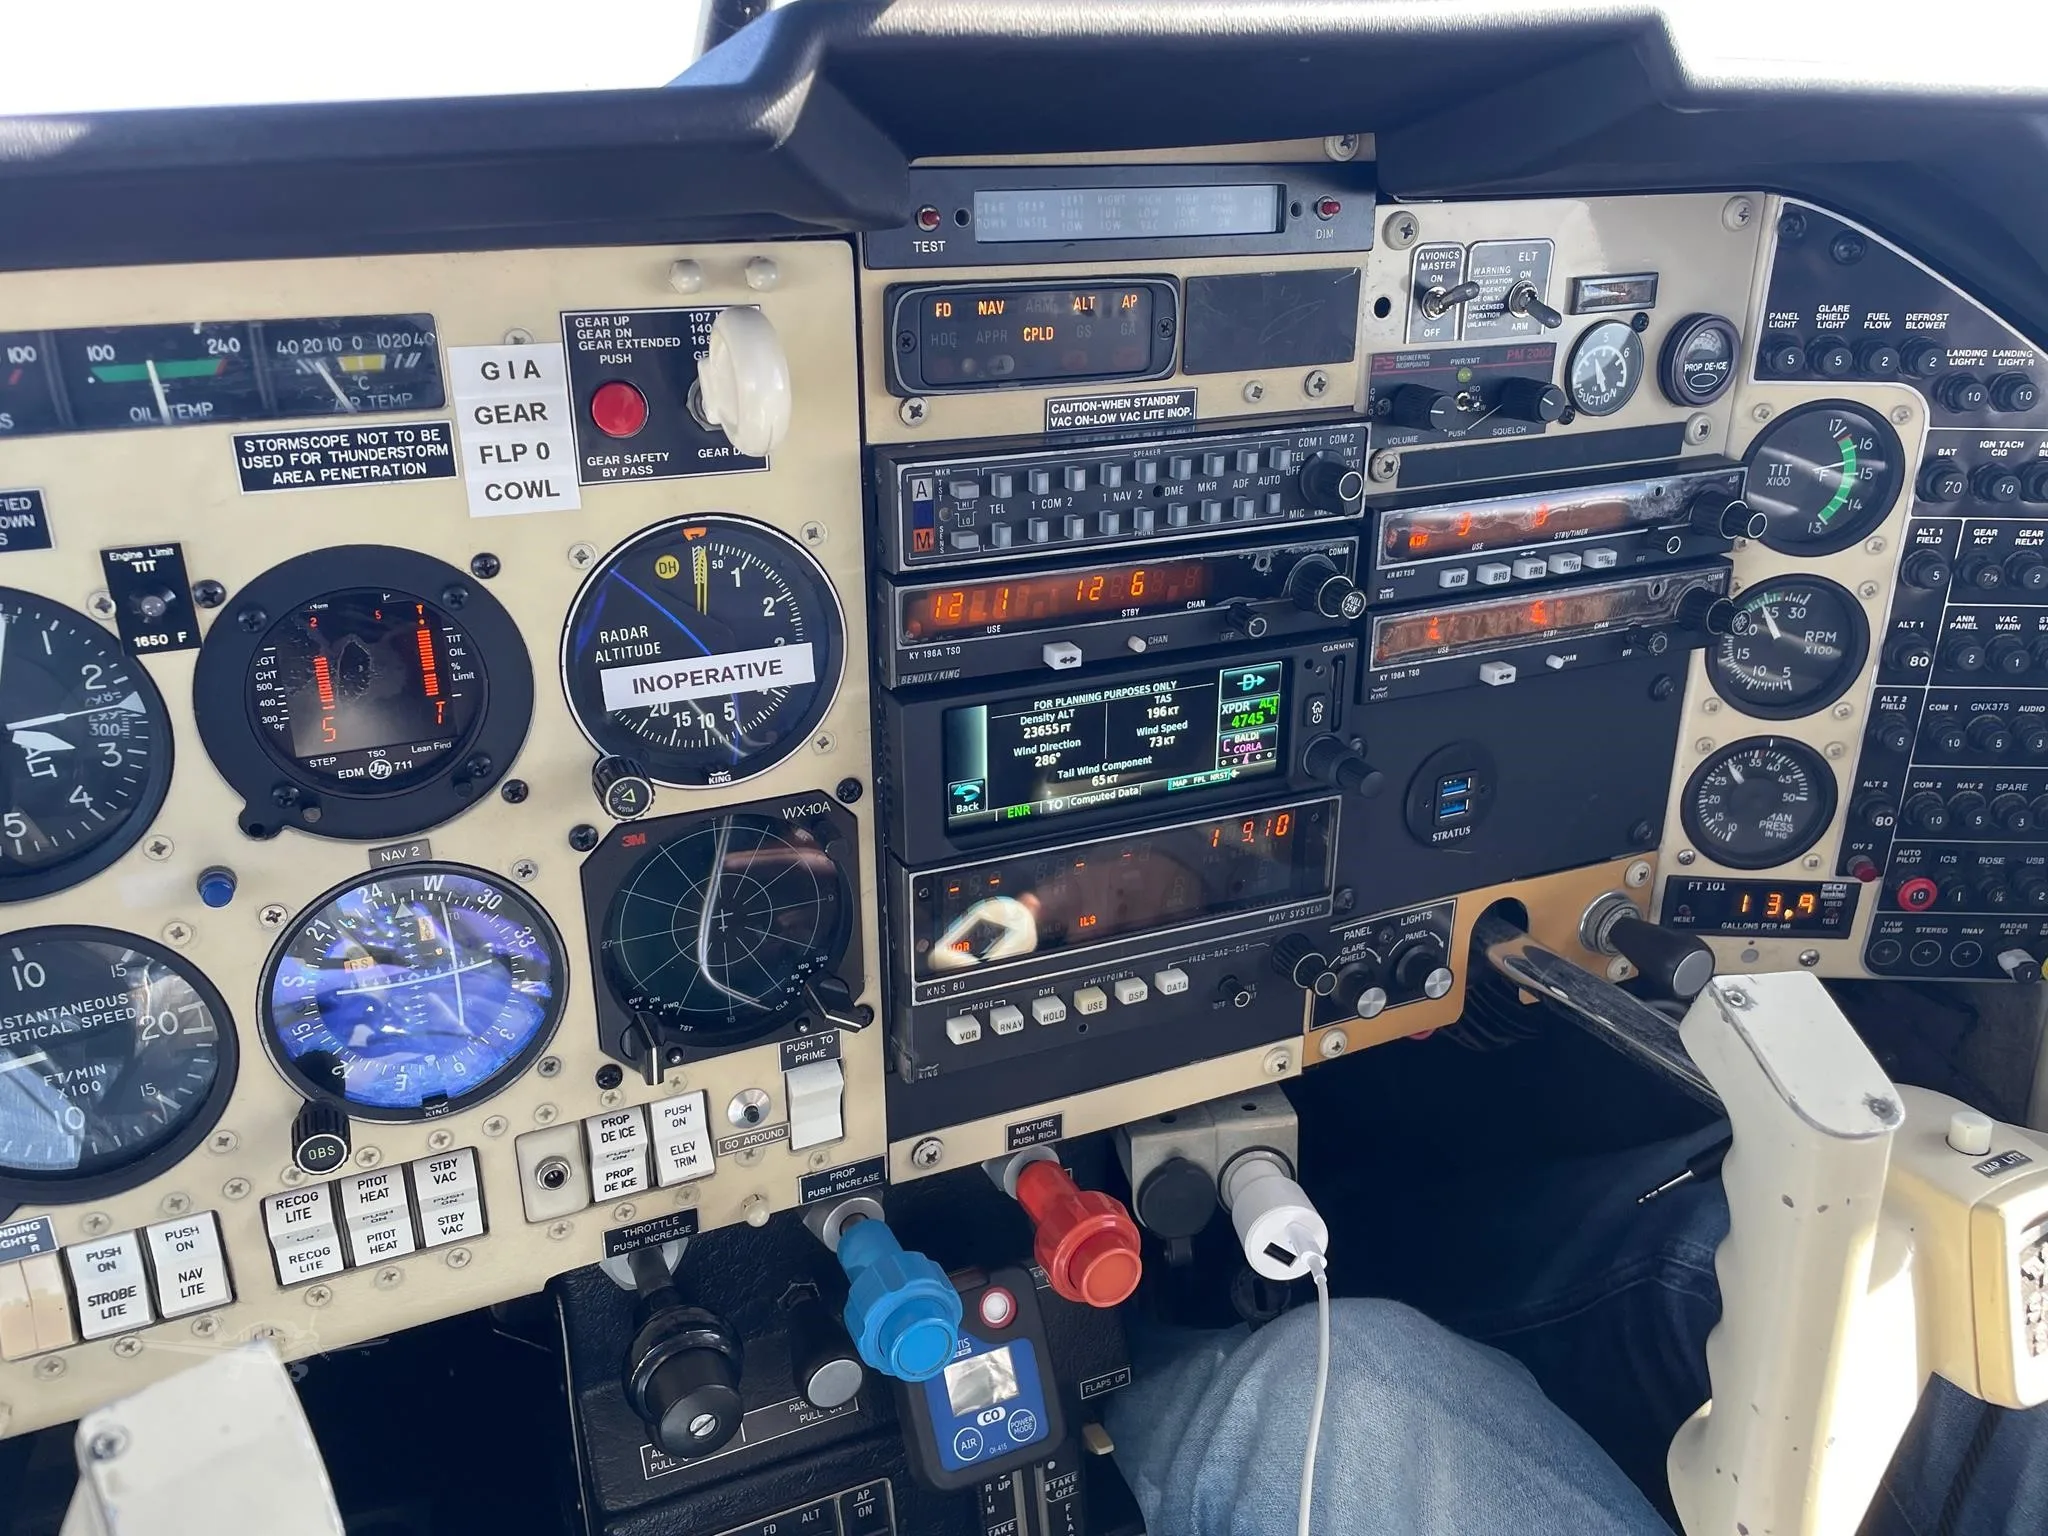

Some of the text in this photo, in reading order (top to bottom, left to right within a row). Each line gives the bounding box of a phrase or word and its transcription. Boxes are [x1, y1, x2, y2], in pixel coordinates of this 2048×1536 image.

[913, 241, 945, 252] TEST
[1419, 251, 1460, 261] AVIONICS
[1518, 251, 1538, 262] ELT
[1421, 261, 1456, 270] MASTER
[936, 295, 1138, 317] FD NAV ALT AP
[1818, 305, 1850, 313] GLARE
[575, 316, 629, 328] GEAR UP
[1769, 313, 1800, 321] PANEL
[1816, 313, 1850, 321] SHIELD
[1867, 313, 1891, 321] FUEL
[1769, 321, 1797, 329] LIGHT
[1817, 321, 1846, 329] LIGHT
[1864, 321, 1892, 329] FLOW
[1905, 321, 1946, 329] BLOWER
[1023, 325, 1054, 341] CPLD
[578, 336, 681, 351] GEAR EXTENDED
[600, 353, 632, 365] PUSH
[1051, 395, 1179, 414] CAUTION-WHEN STANDBY
[1578, 388, 1617, 406] SUCTION
[129, 403, 214, 423] OIL TEMP
[474, 402, 548, 425] GEAR
[1050, 416, 1074, 427] VAC
[1075, 413, 1118, 425] ON-LOW
[1120, 412, 1141, 422] VAC
[1144, 410, 1165, 421] LITE
[244, 429, 441, 453] STORMSCOPE NOT TO BE
[242, 444, 448, 470] USED FOR THUNDERSTORM
[480, 442, 528, 464] FLP
[587, 452, 670, 467] GEAR SAFETY
[272, 462, 427, 485] AREA PENETRATION
[602, 465, 654, 478] BY PASS
[485, 480, 560, 502] COWL
[990, 475, 1280, 514] TEL COM DME MKR ADF AUTO
[1916, 536, 1942, 544] FIELD
[109, 547, 174, 562] Engine Limit
[132, 561, 157, 573] TIT
[133, 632, 187, 647] 1650 F
[600, 625, 649, 644] RADAR
[1804, 631, 1837, 643] RPM
[595, 642, 662, 663] ALTITUDE
[1322, 642, 1354, 652] GARMIN
[1910, 656, 1929, 667] 80
[632, 659, 784, 695] INOPERATIVE
[901, 669, 960, 685] BENDIX/KING
[1034, 681, 1177, 711] FOR PLANNING PURPOSES ONLY
[1155, 695, 1172, 704] TAS
[1221, 703, 1250, 715] XPDR
[1970, 703, 2009, 711] GNX375
[1020, 709, 1075, 726] Density ALT
[1231, 712, 1265, 728] 4745
[1136, 721, 1188, 737] Wind Speed
[1013, 739, 1081, 757] Wind Direction
[309, 756, 337, 768] STEP
[1057, 756, 1152, 779] Tail Wind Component
[338, 760, 414, 780] EDM 711
[709, 774, 731, 785] KING
[1995, 783, 2028, 792] SPARE
[956, 802, 979, 813] Back
[1007, 787, 1138, 818] ENR Computed Data
[782, 802, 832, 820] WX-10A
[621, 832, 646, 847] 3M
[1432, 826, 1471, 842] STRATUS
[381, 847, 420, 862] NAV 2
[1940, 855, 1957, 864] ICS
[1978, 857, 2005, 865] BOSE
[1343, 911, 1433, 941] PANEL LIGHTS
[1721, 922, 1759, 930] GALLONS
[81, 1007, 137, 1029] SPEED
[959, 980, 1188, 1041] VOR RNAV HOLD USE DATA
[786, 1035, 834, 1054] PUSH TO
[795, 1048, 826, 1063] PRIME
[664, 1103, 693, 1117] PUSH
[672, 1116, 686, 1128] ON
[1015, 1118, 1055, 1135] MIXTURE
[724, 1127, 785, 1150] GO AROUND
[1013, 1130, 1058, 1146] PUSH RICH
[308, 1145, 336, 1160] OBS
[670, 1141, 696, 1156] ELEV
[429, 1159, 458, 1173] STBY
[673, 1155, 698, 1168] TRIM
[1978, 1152, 2025, 1176] MAP LITE
[433, 1171, 458, 1184] VAC
[829, 1168, 856, 1180] PROP
[357, 1174, 388, 1190] PITOT
[807, 1172, 880, 1198] PUSH INCREASE
[275, 1191, 319, 1211] RECOG
[360, 1187, 390, 1203] HEAT
[285, 1207, 311, 1223] LITE
[622, 1216, 680, 1238] THROTTLE
[613, 1225, 692, 1253] PUSH INCREASE
[178, 1267, 204, 1284] NAV
[88, 1286, 138, 1307] STROBE
[180, 1282, 206, 1299] LITE
[101, 1304, 127, 1320] LITE
[1085, 1374, 1126, 1393] FLAPS UP
[982, 1409, 1001, 1423] CO
[1010, 1415, 1034, 1429] POWER
[1013, 1423, 1033, 1434] MODE
[960, 1437, 978, 1451] AIR
[801, 1490, 870, 1524] ALT AP
